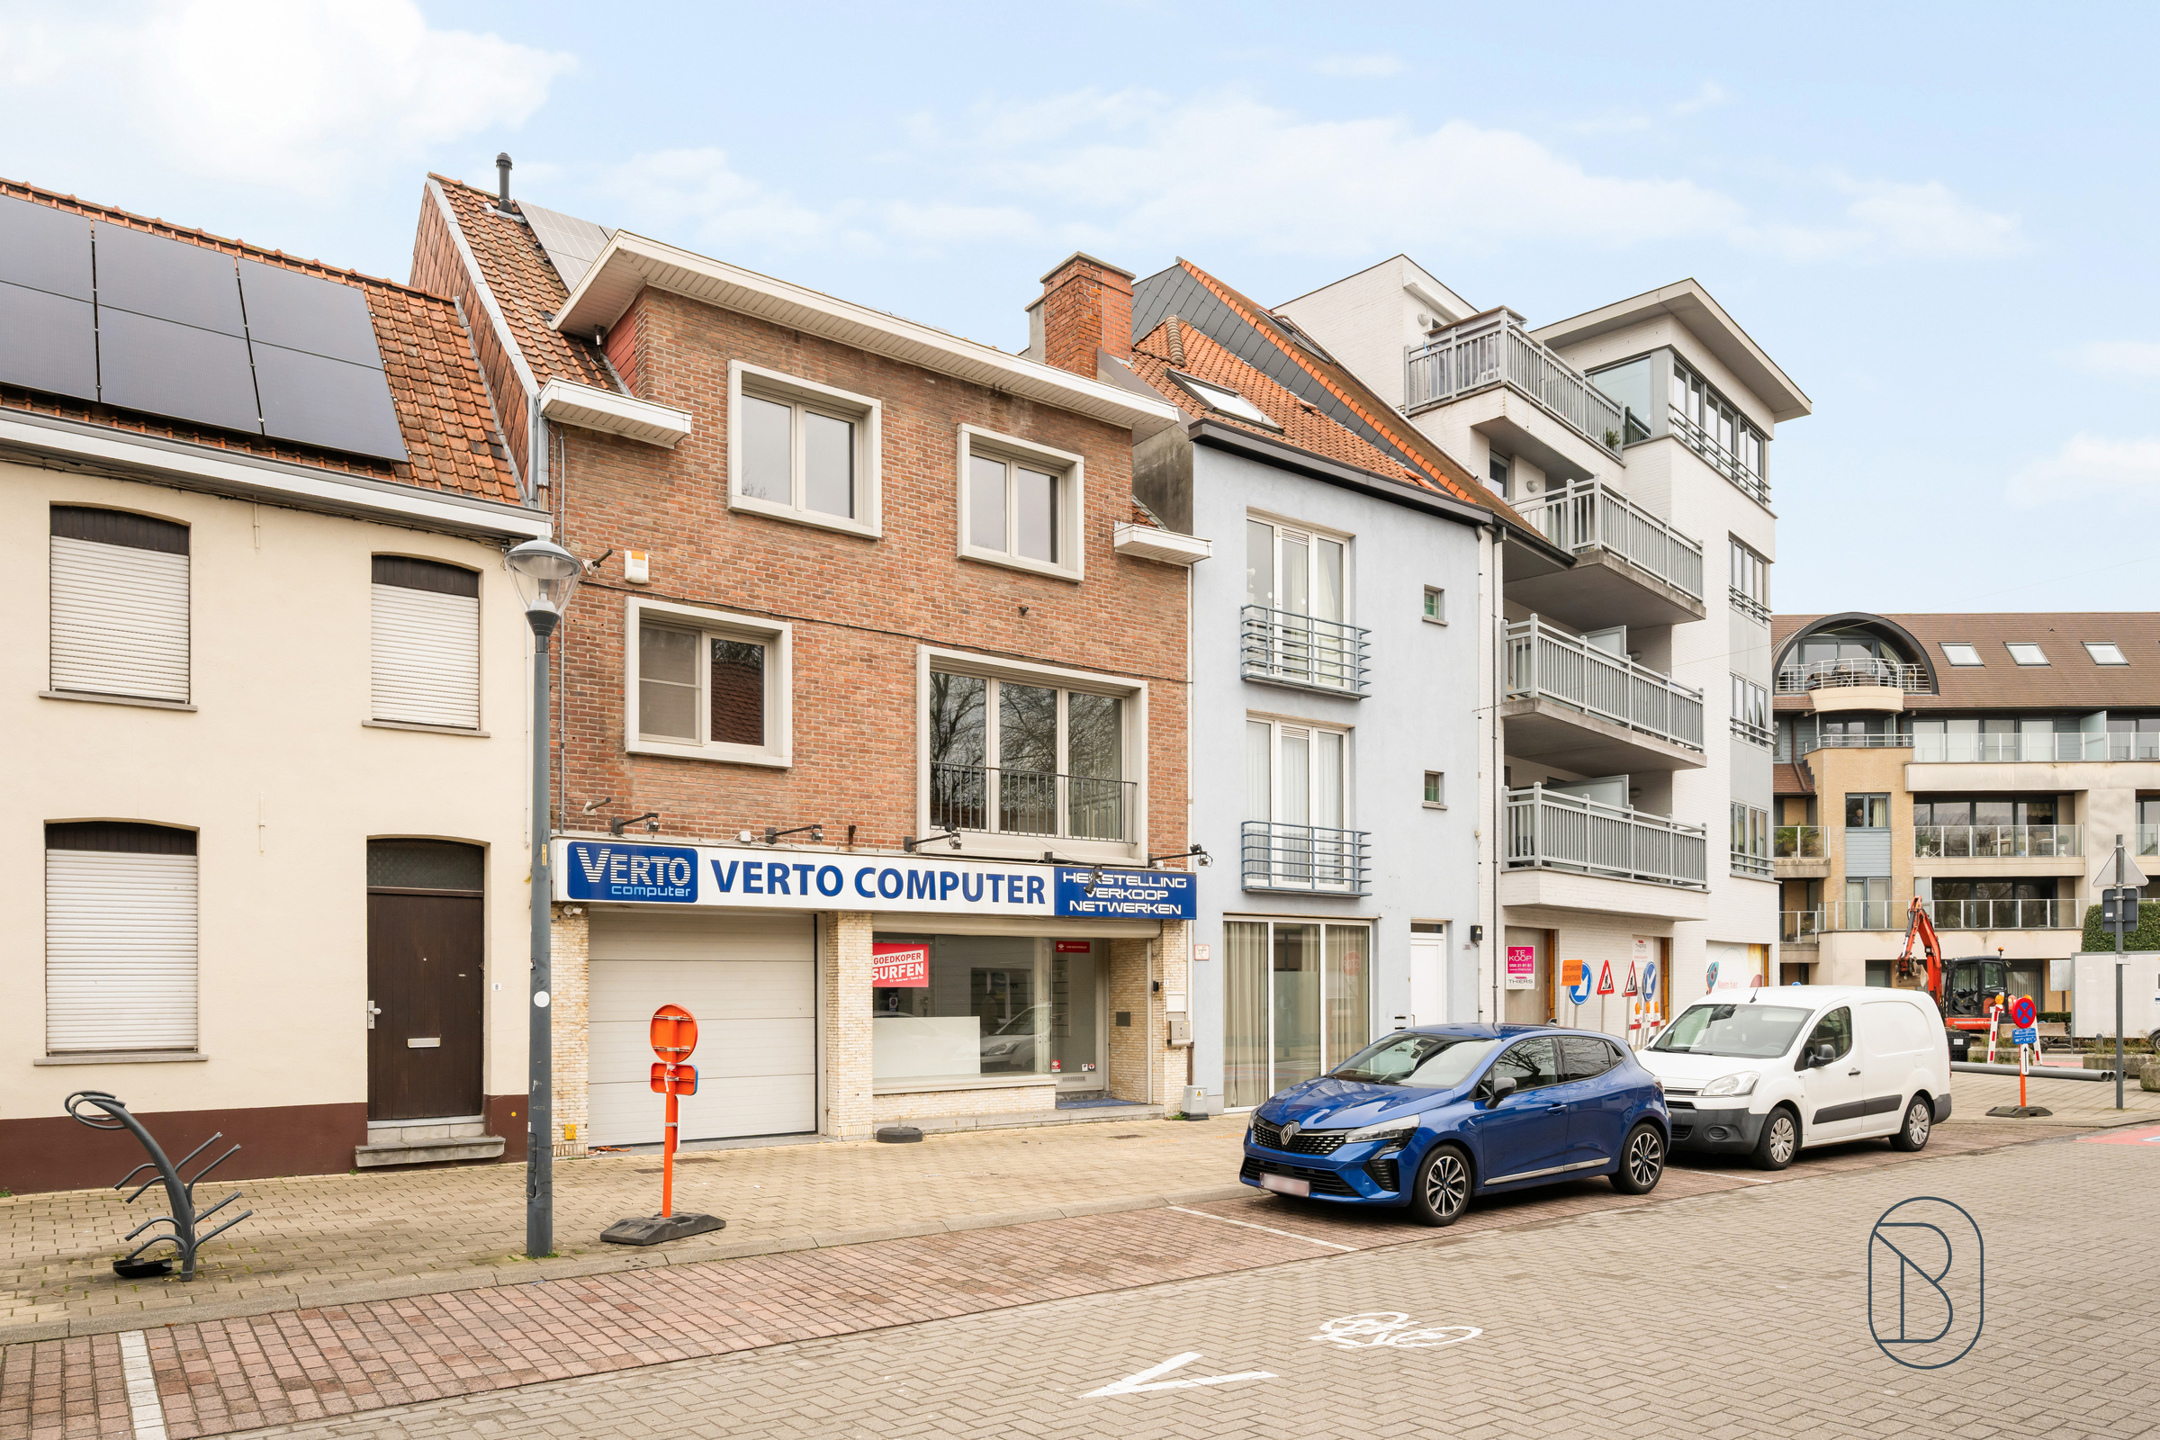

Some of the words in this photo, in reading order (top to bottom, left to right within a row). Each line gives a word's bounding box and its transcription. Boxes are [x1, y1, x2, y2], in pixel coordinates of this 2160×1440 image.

[576, 846, 691, 886] VERTO
[711, 860, 844, 898] VERTO
[854, 867, 1046, 905] COMPUTER
[611, 885, 691, 898] computer
[1069, 900, 1182, 915] NETWERKEN
[873, 952, 922, 965] GOEDKOPER
[1515, 949, 1526, 957] TE
[872, 962, 924, 981] SURFEN
